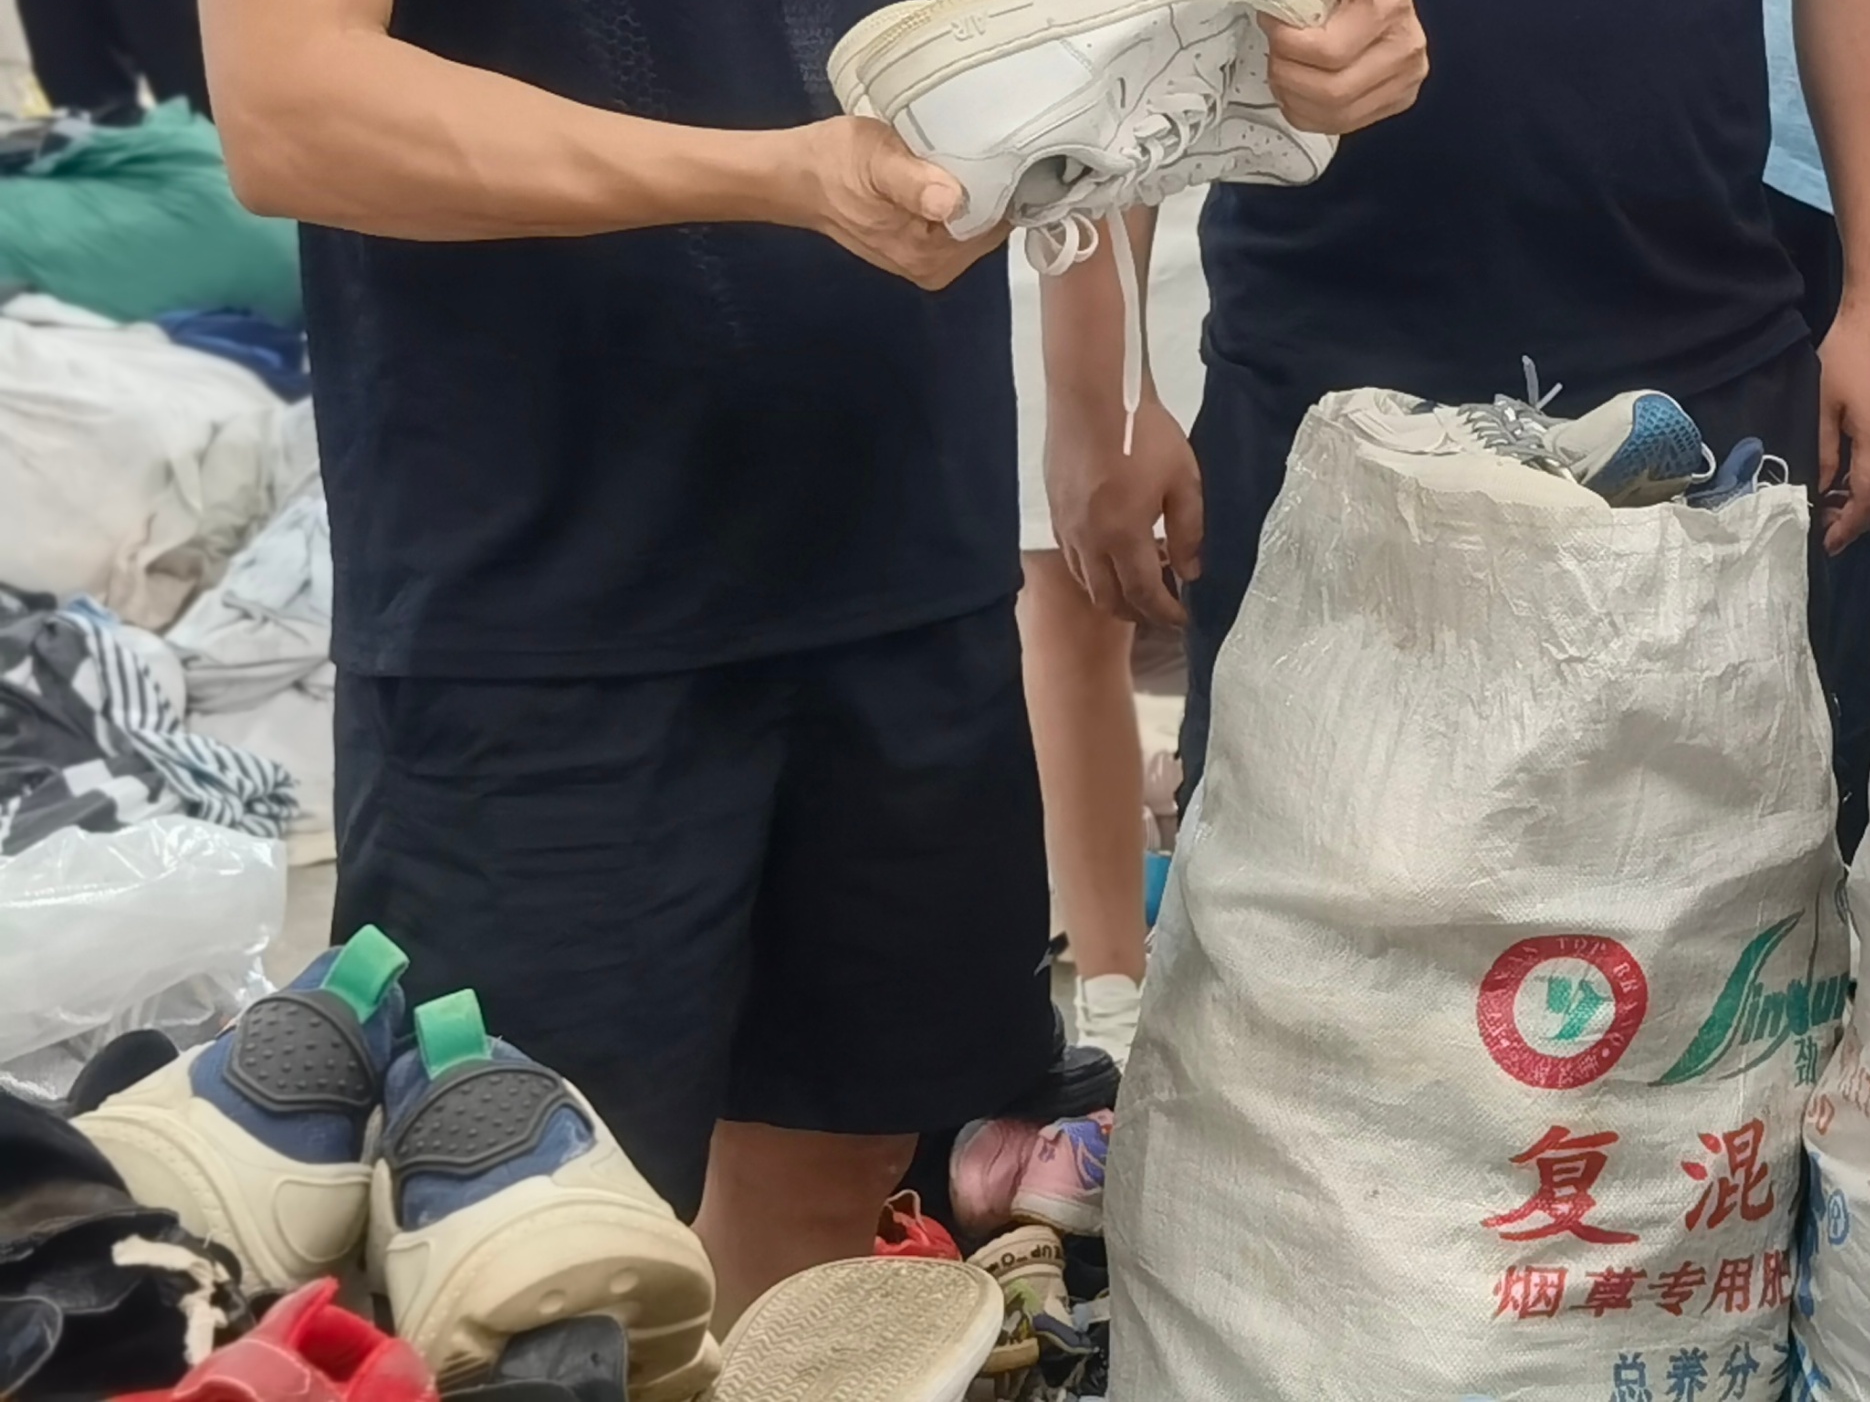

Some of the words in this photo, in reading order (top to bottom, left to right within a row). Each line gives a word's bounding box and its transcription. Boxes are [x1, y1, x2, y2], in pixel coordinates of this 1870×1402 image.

[1480, 1118, 1776, 1244] 复混
[1491, 1250, 1792, 1320] 烟草专用肥
